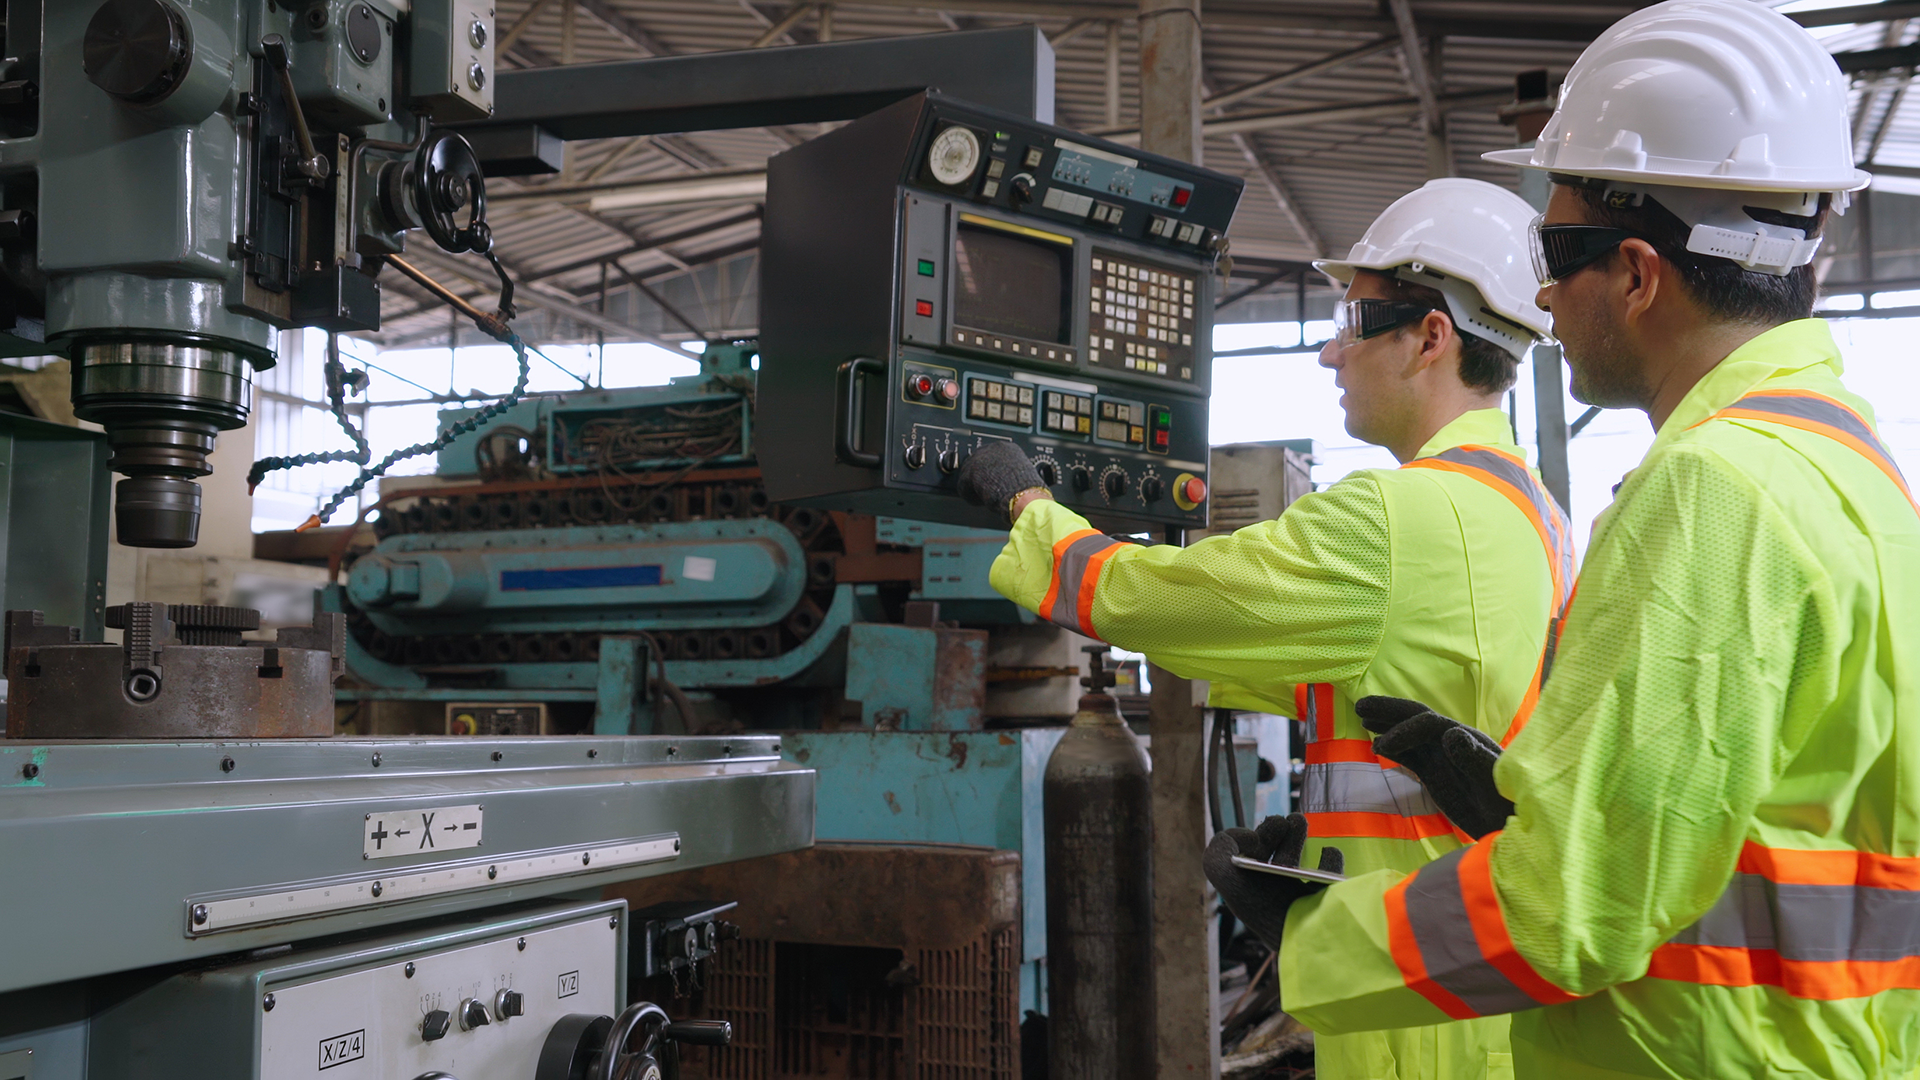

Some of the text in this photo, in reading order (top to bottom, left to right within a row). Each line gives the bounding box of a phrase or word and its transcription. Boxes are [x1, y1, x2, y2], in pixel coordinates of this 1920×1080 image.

[419, 812, 435, 849] X
[561, 976, 576, 992] Y/Z
[323, 1037, 360, 1063] X/Z/4
